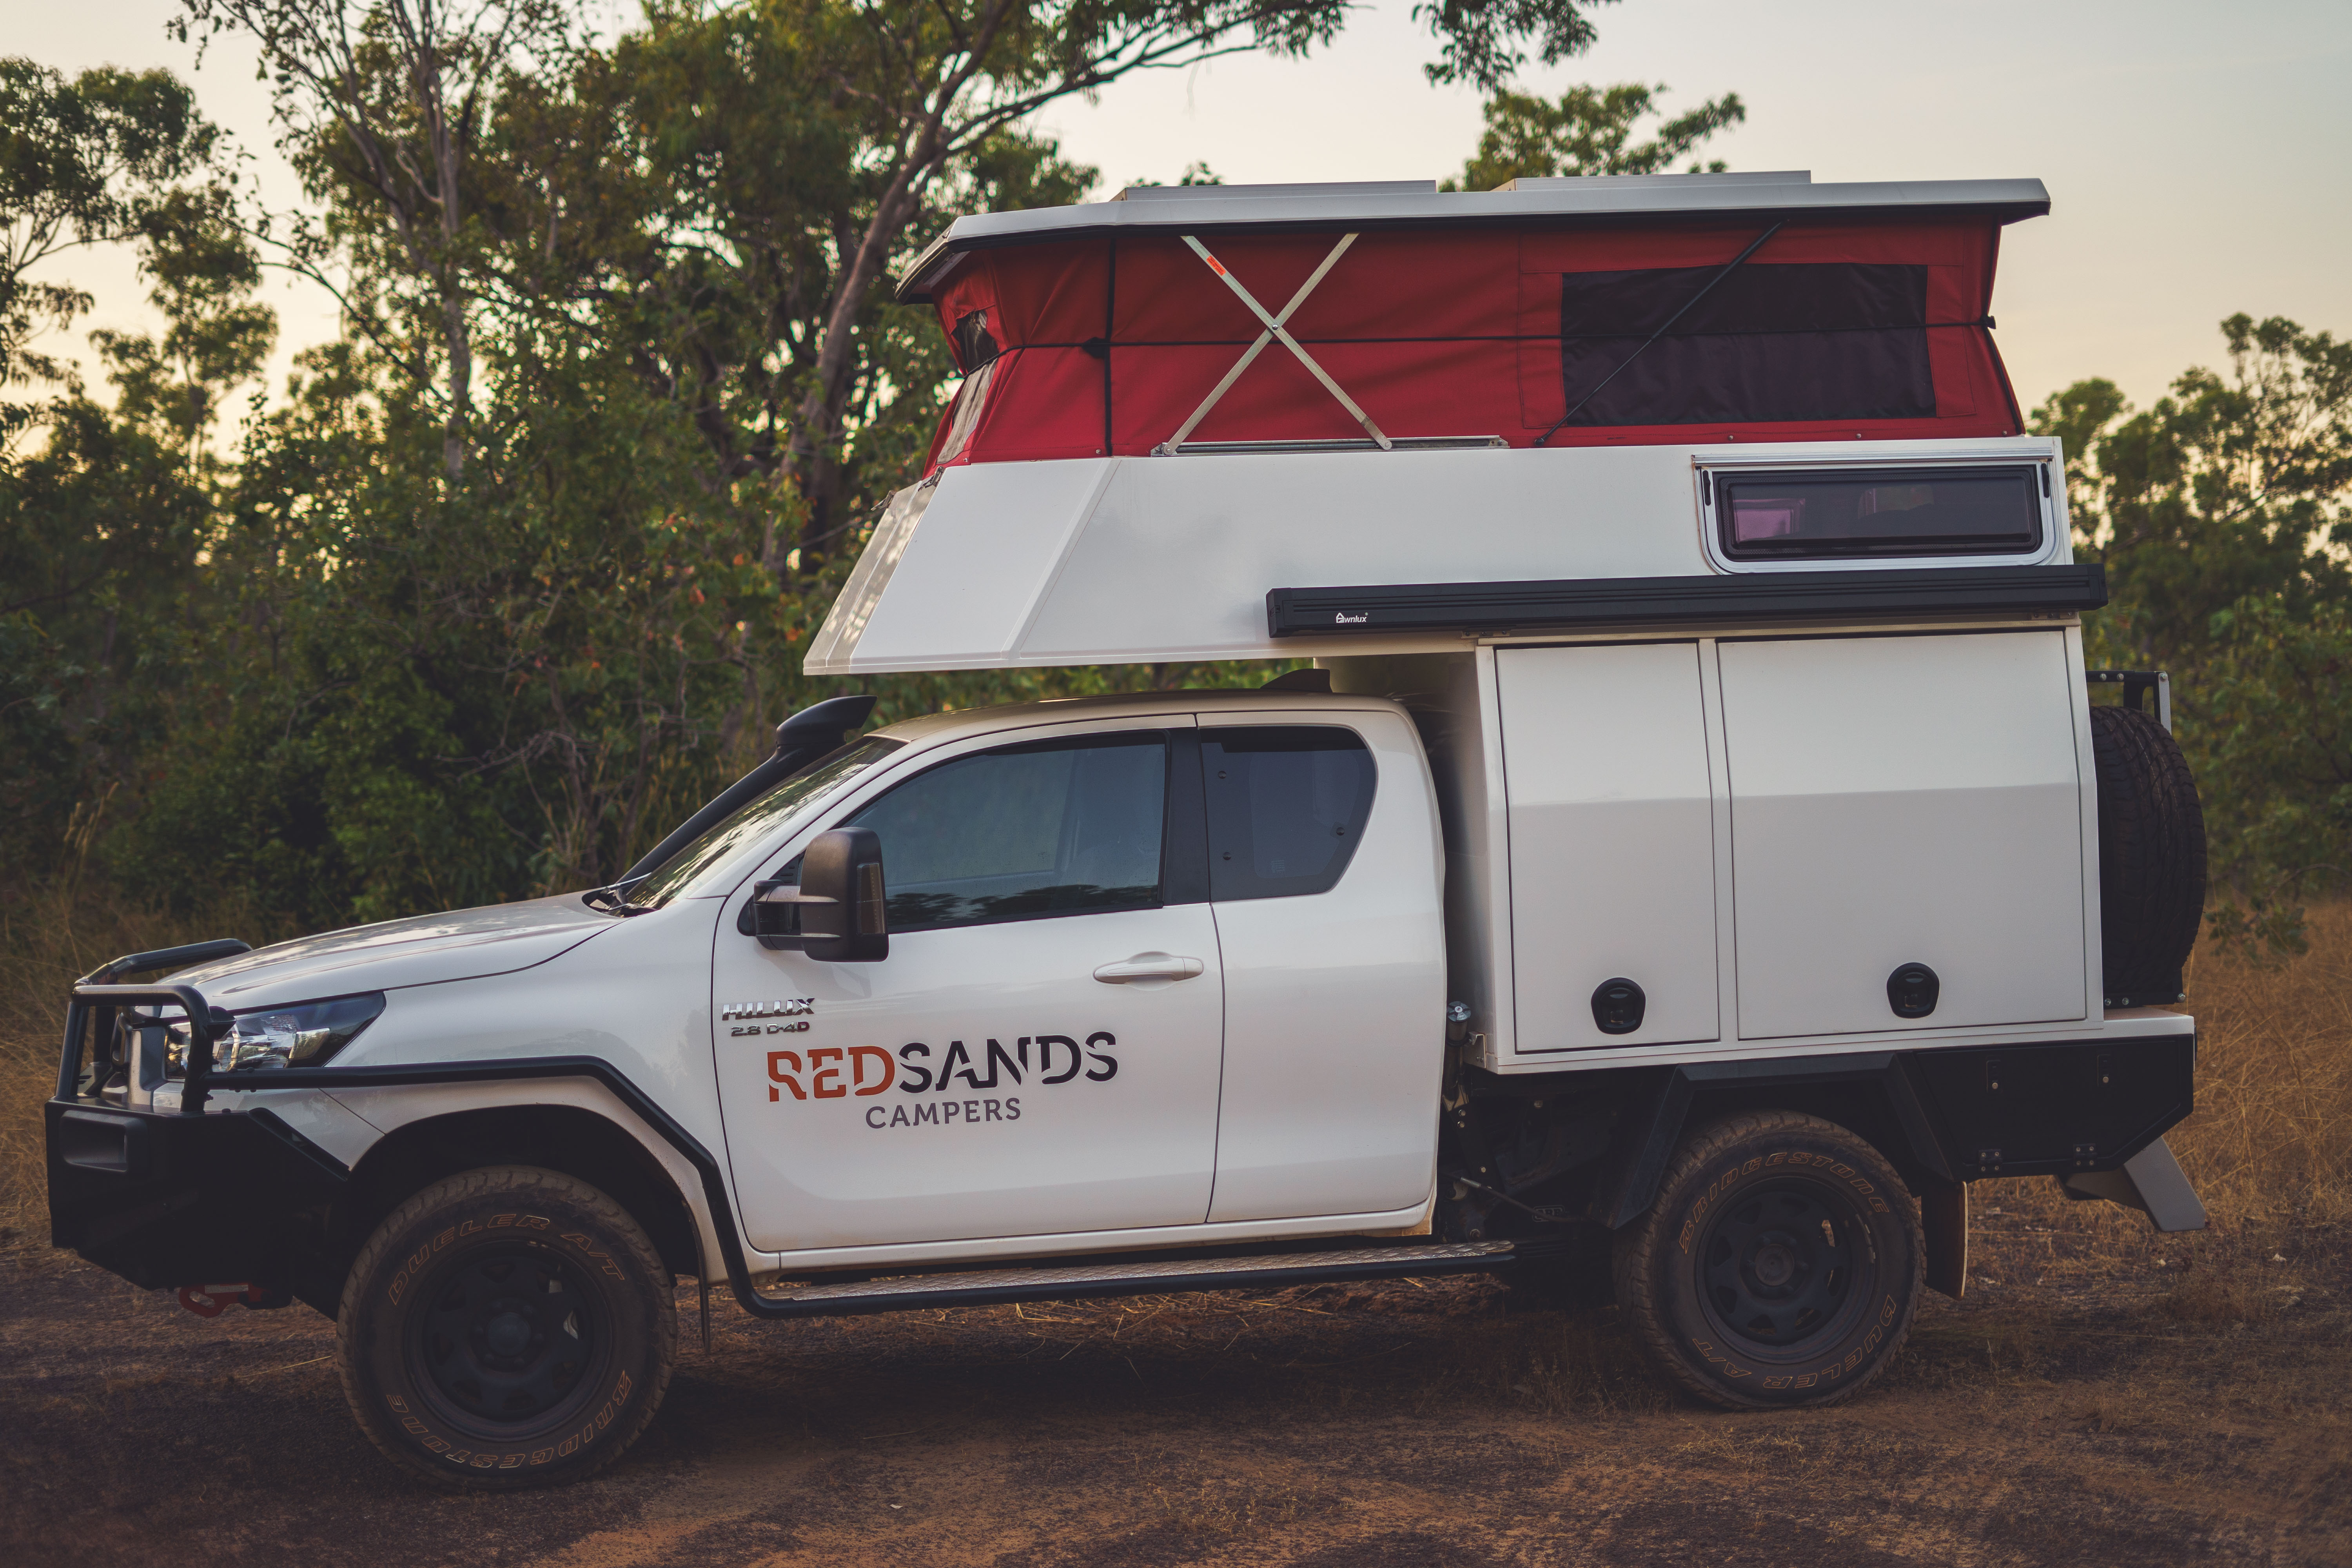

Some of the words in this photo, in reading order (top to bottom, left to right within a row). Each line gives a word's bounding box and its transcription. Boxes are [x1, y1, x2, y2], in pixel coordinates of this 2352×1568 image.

[1336, 612, 1367, 623] Awnlux
[722, 998, 815, 1021] HILUX
[731, 1024, 761, 1037] 2.8
[767, 1021, 810, 1034] D-4D
[766, 1031, 1118, 1102] REDSANDS
[866, 1097, 1021, 1129] CAMPERS
[1679, 1152, 1889, 1254] BRIDGESTONE
[388, 1214, 550, 1305] DUELER
[560, 1233, 625, 1281] A/T
[1692, 1338, 1751, 1377] A/T
[1763, 1294, 1896, 1389] DUELER
[387, 1370, 632, 1469] BRIDGESTONE
